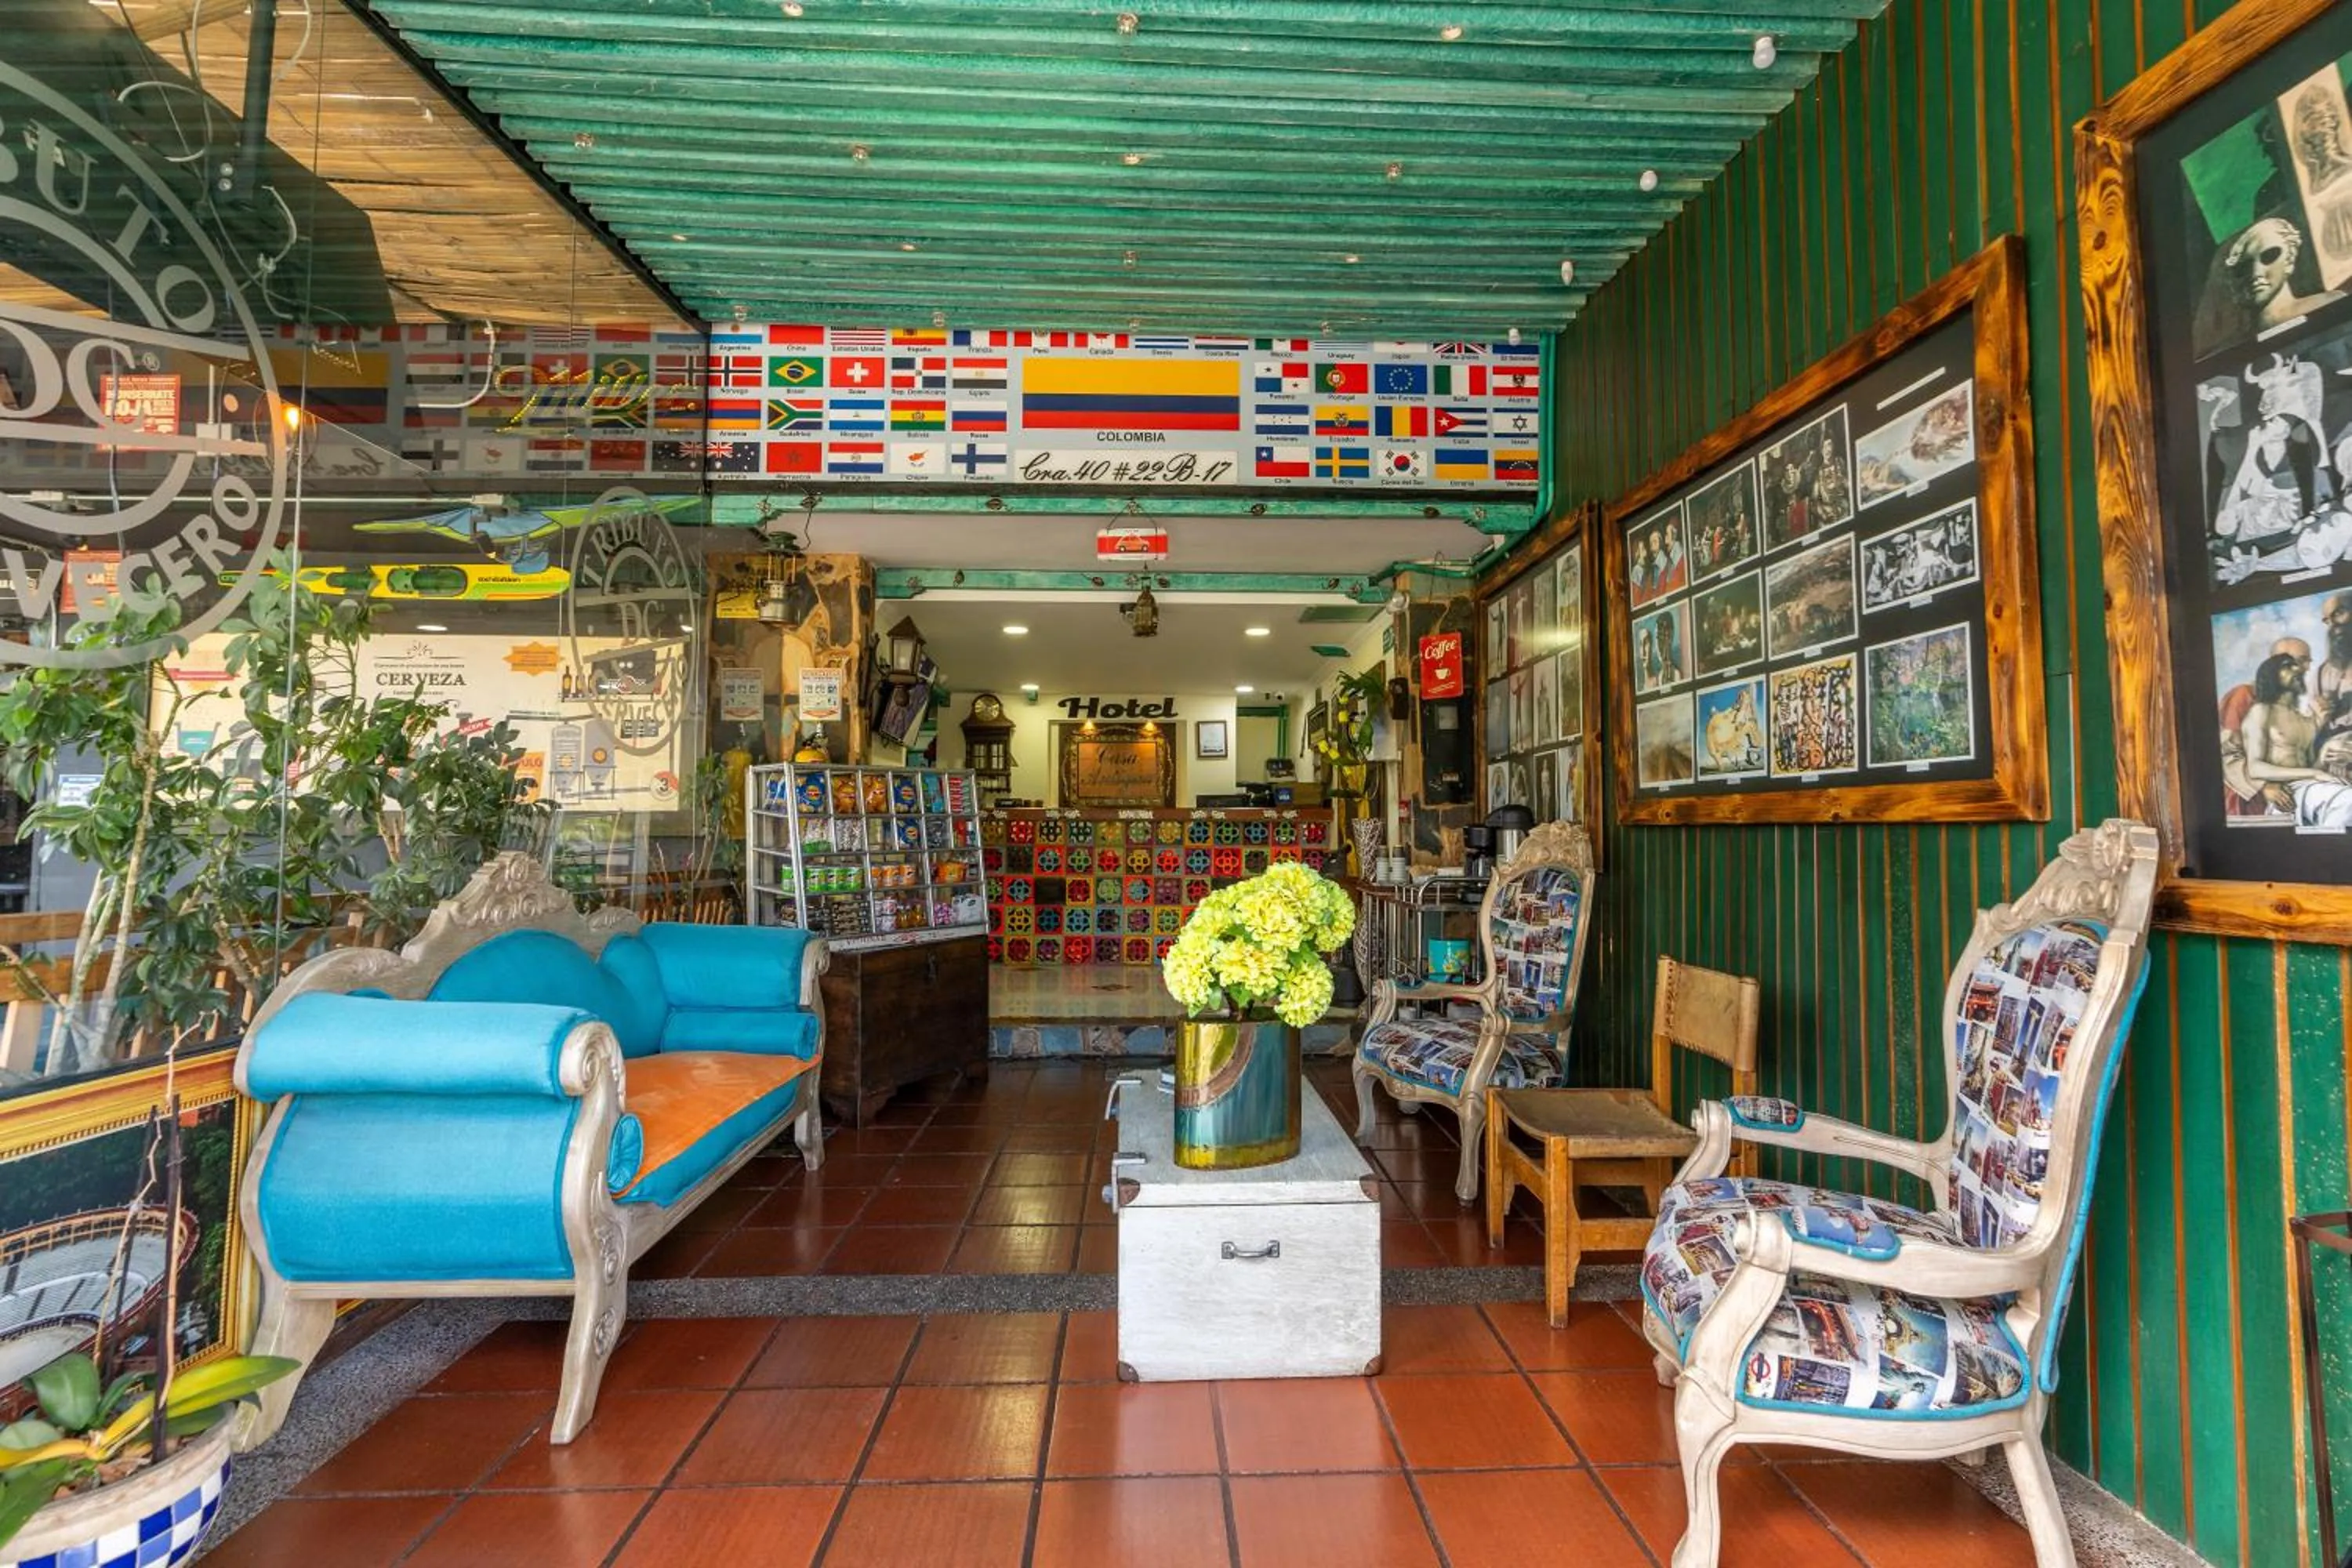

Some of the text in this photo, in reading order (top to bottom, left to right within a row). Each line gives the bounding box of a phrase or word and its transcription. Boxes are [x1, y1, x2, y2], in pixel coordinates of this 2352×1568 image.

[1097, 431, 1166, 442] COLOMBIA
[1424, 639, 1457, 660] Coffee
[376, 672, 467, 686] CERVEZA
[1058, 697, 1179, 719] Hotel
